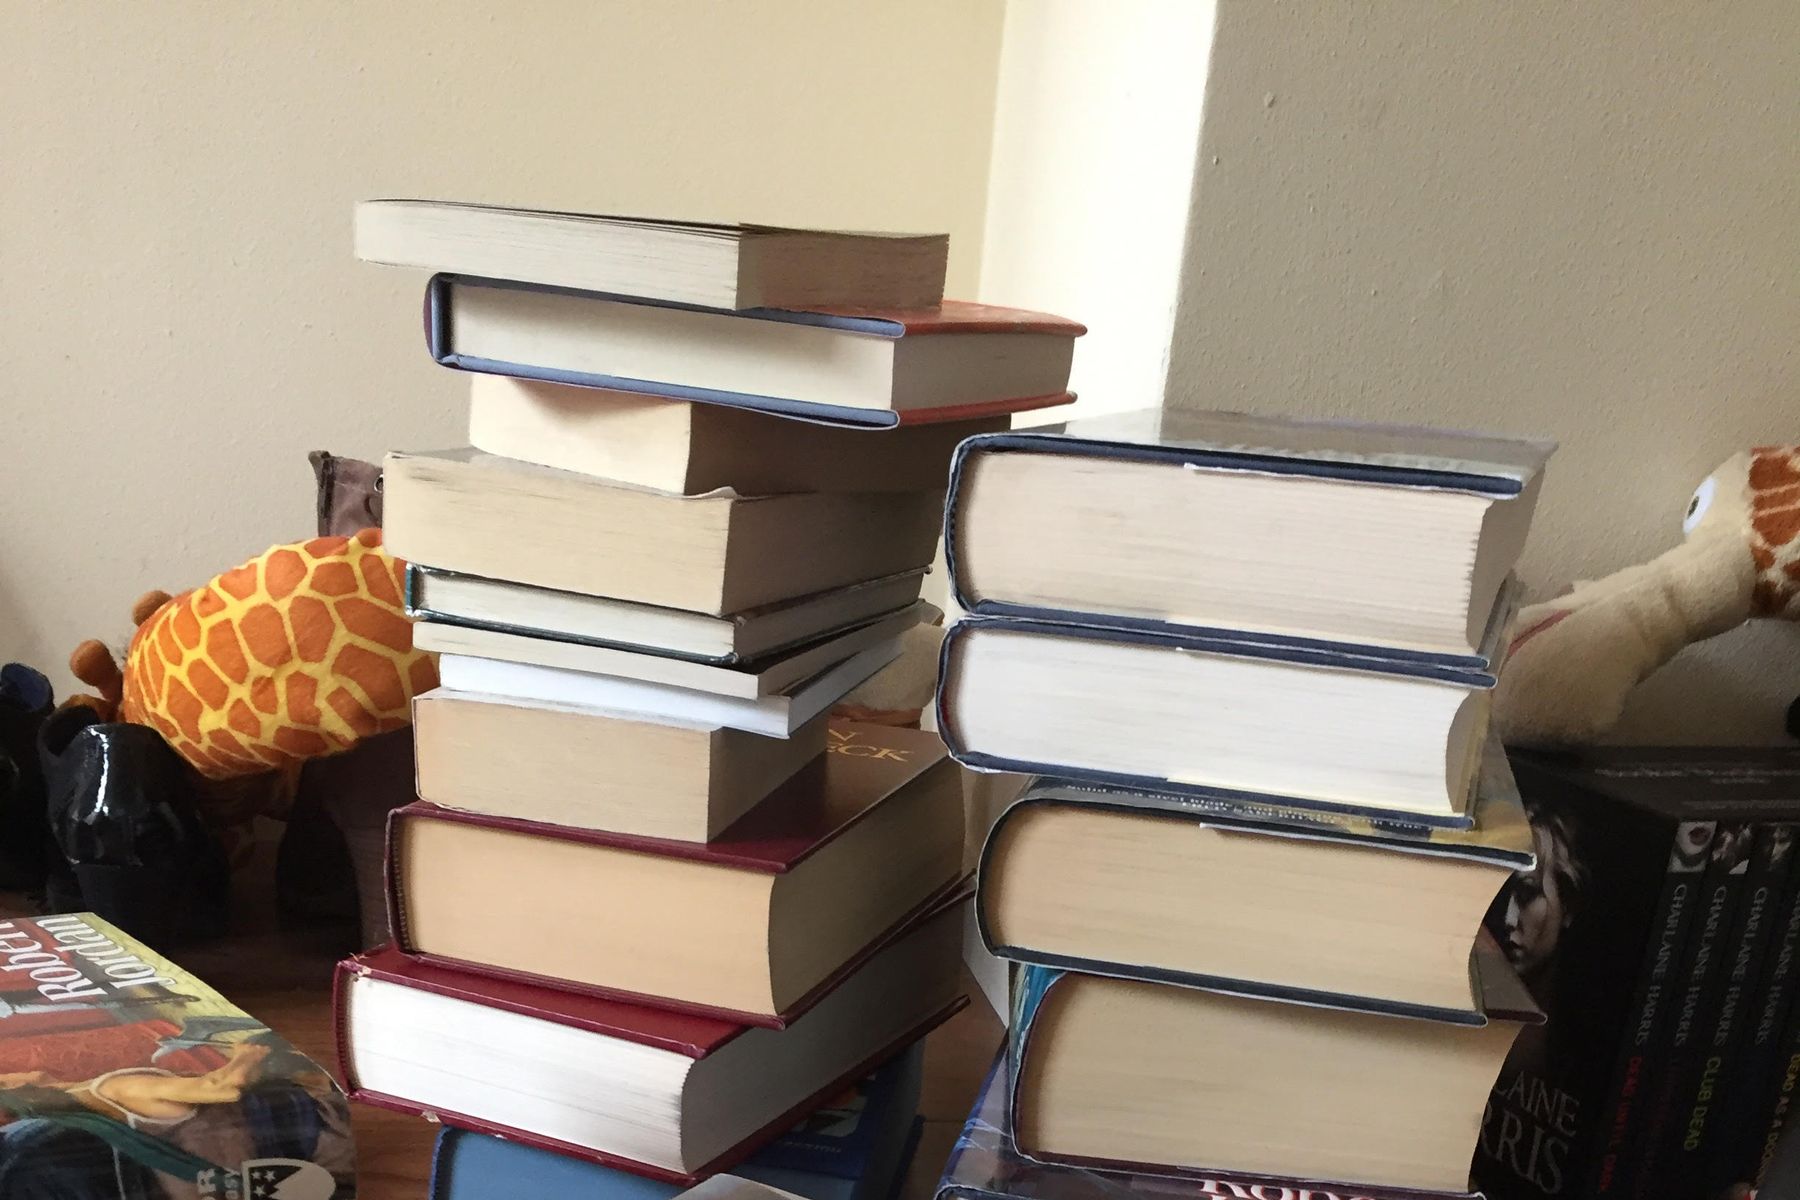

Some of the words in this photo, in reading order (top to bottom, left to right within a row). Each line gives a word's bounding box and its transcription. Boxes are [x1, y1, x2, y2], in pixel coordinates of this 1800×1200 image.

[36, 916, 177, 989] Jordan
[1652, 884, 1687, 981] CHARLAINE
[1692, 886, 1726, 981] CHARLAINE
[1731, 887, 1768, 981] CHARLAINE
[1635, 984, 1661, 1046] HARRIS
[1674, 986, 1700, 1046] HARRIS
[1713, 986, 1740, 1046] HARRIS
[1698, 1056, 1721, 1101] CLUB
[1684, 1106, 1707, 1151] DEAD
